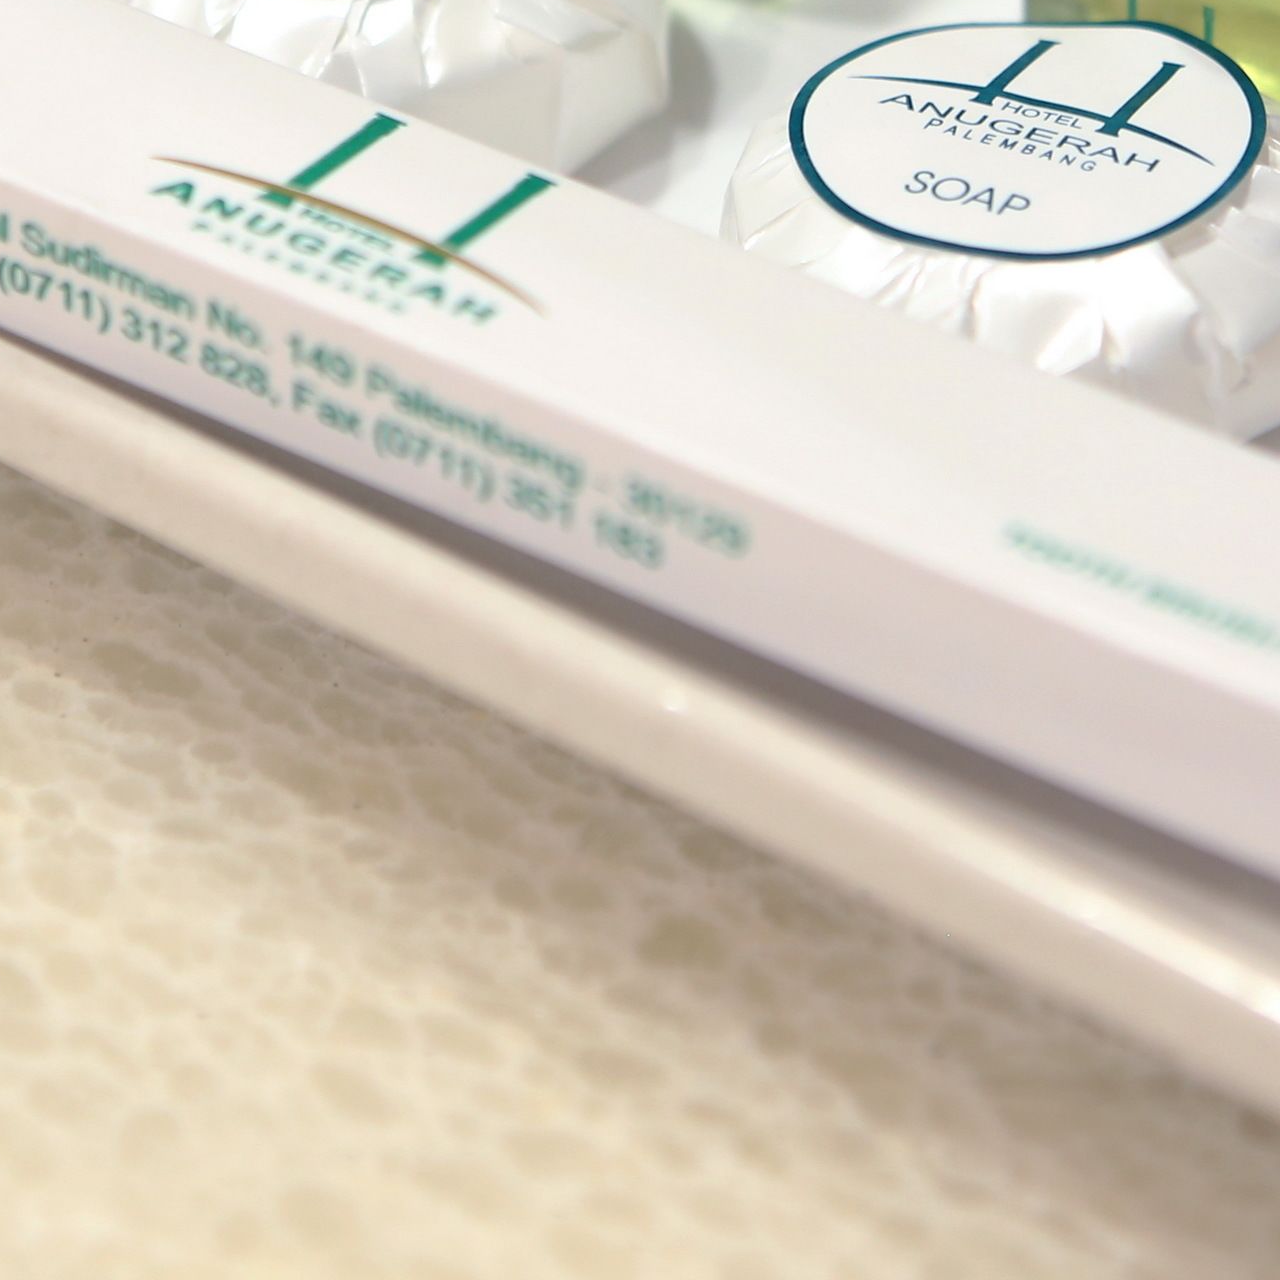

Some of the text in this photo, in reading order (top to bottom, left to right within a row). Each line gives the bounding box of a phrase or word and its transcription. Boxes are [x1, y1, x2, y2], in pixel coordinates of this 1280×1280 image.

[878, 93, 1161, 173] ANUGERAH
[923, 119, 1097, 172] PALEMBANG
[1001, 101, 1083, 130] HOTEL
[904, 170, 1031, 216] SOAP
[148, 180, 499, 325] ANUGERAH
[21, 220, 195, 319] Sudirman
[205, 300, 267, 353] No.
[365, 363, 587, 492] Palembang
[121, 309, 188, 364] 312
[199, 344, 280, 405] 828,
[292, 381, 360, 435] Fax
[372, 419, 496, 503] (0711)
